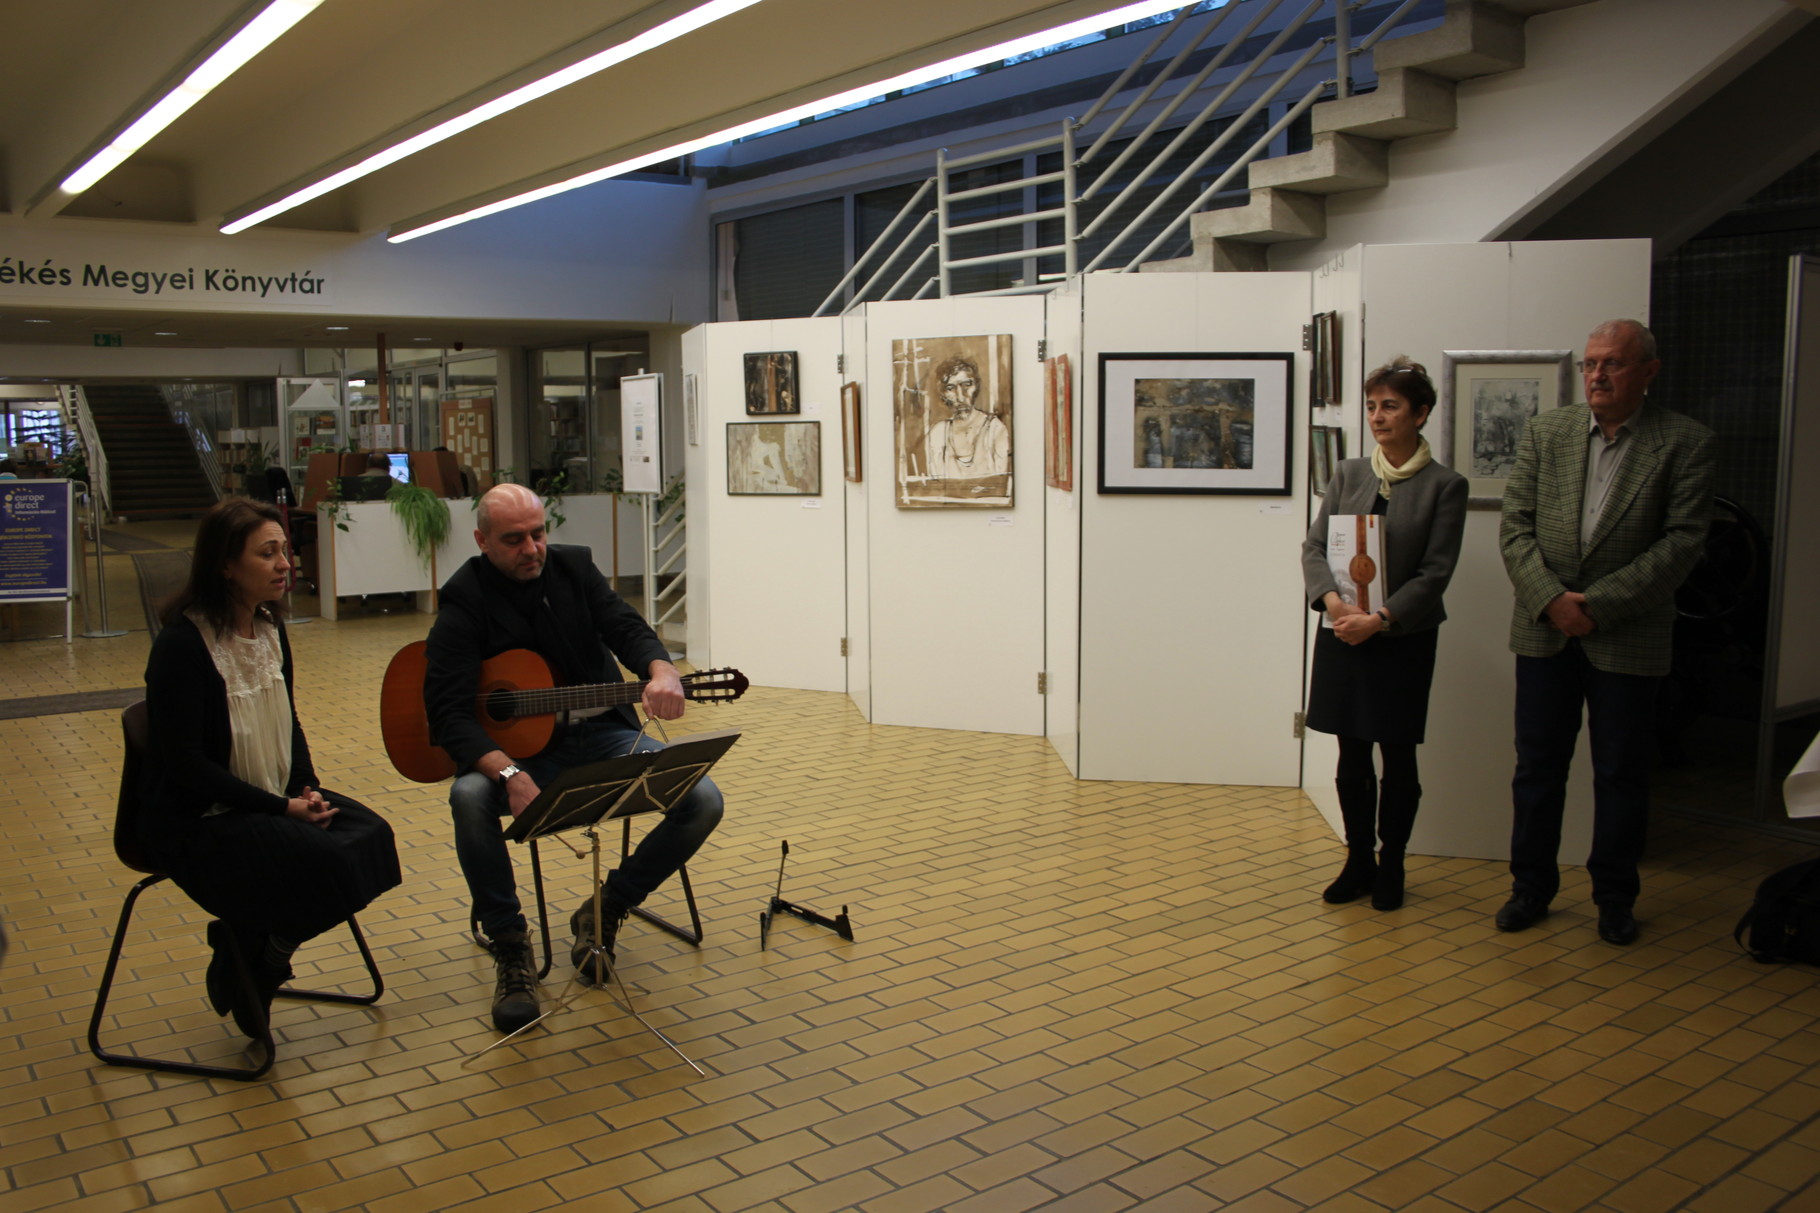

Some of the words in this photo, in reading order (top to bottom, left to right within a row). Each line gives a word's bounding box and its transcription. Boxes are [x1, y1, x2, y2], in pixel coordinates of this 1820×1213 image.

[83, 264, 194, 294] Megyei
[205, 269, 325, 297] Könyvtár
[14, 494, 45, 502] europe
[14, 501, 39, 509] direct
